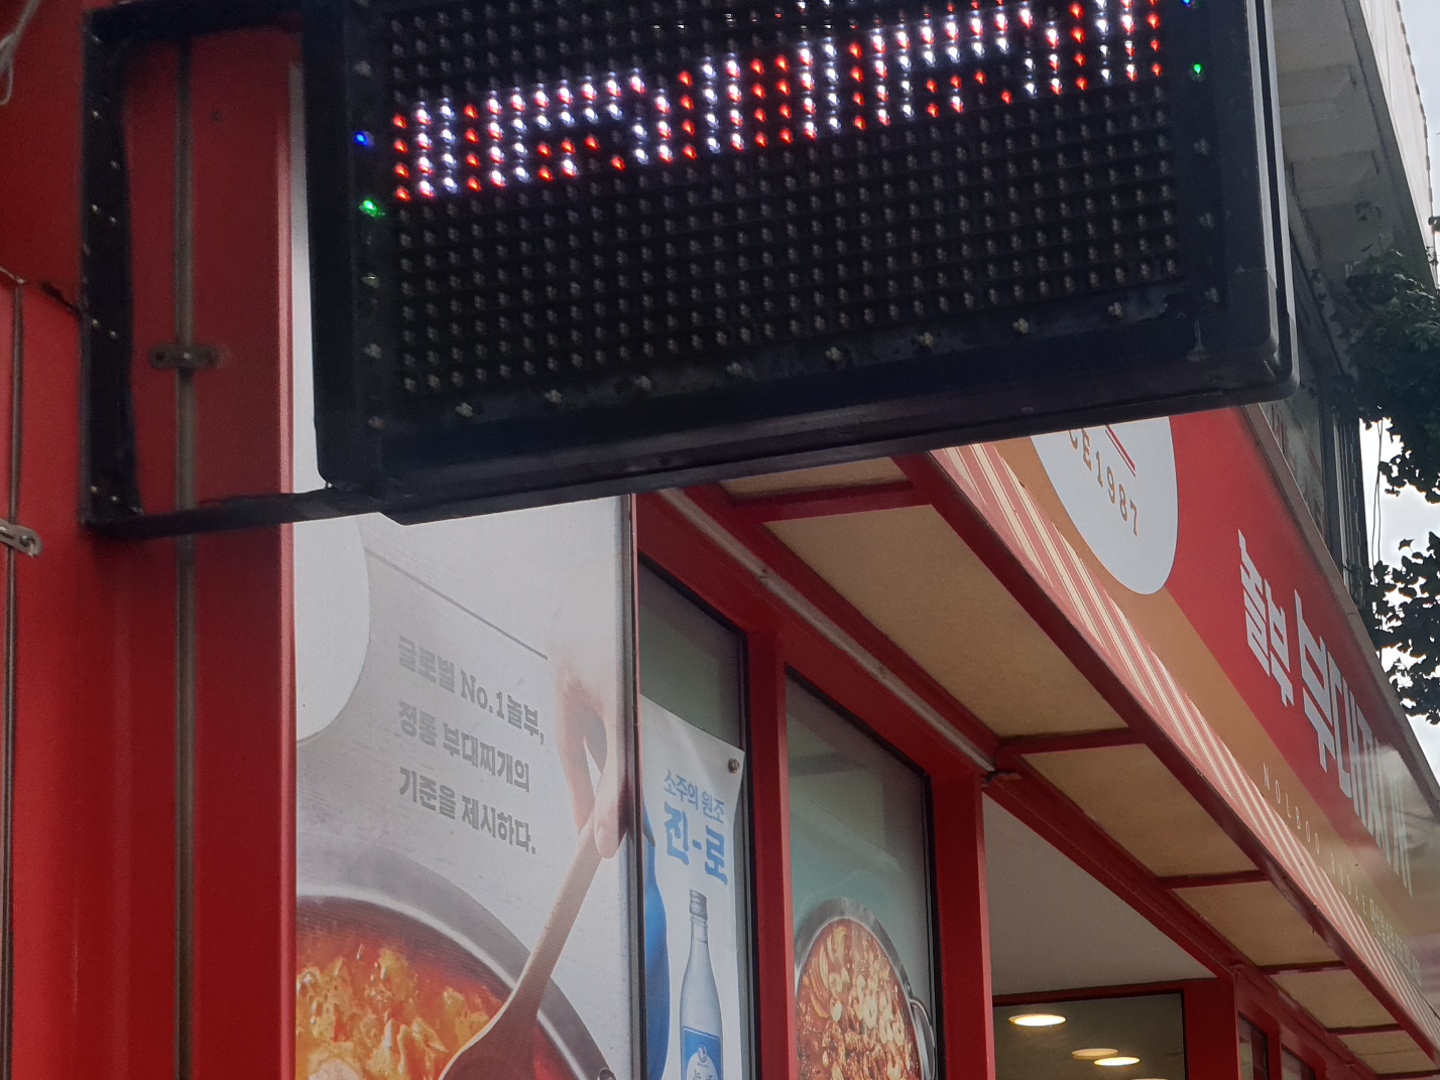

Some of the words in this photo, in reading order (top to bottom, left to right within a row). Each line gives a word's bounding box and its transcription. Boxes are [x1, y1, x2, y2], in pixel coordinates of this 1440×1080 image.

[1237, 528, 1295, 708] 놀부
[399, 635, 456, 693] 글로벌
[398, 700, 438, 747] 정통
[443, 722, 531, 794] 부대찌개의
[399, 765, 457, 821] 기준을
[461, 794, 536, 855] 제시하다.
[663, 768, 699, 811] 소주의
[702, 790, 725, 825] 원조
